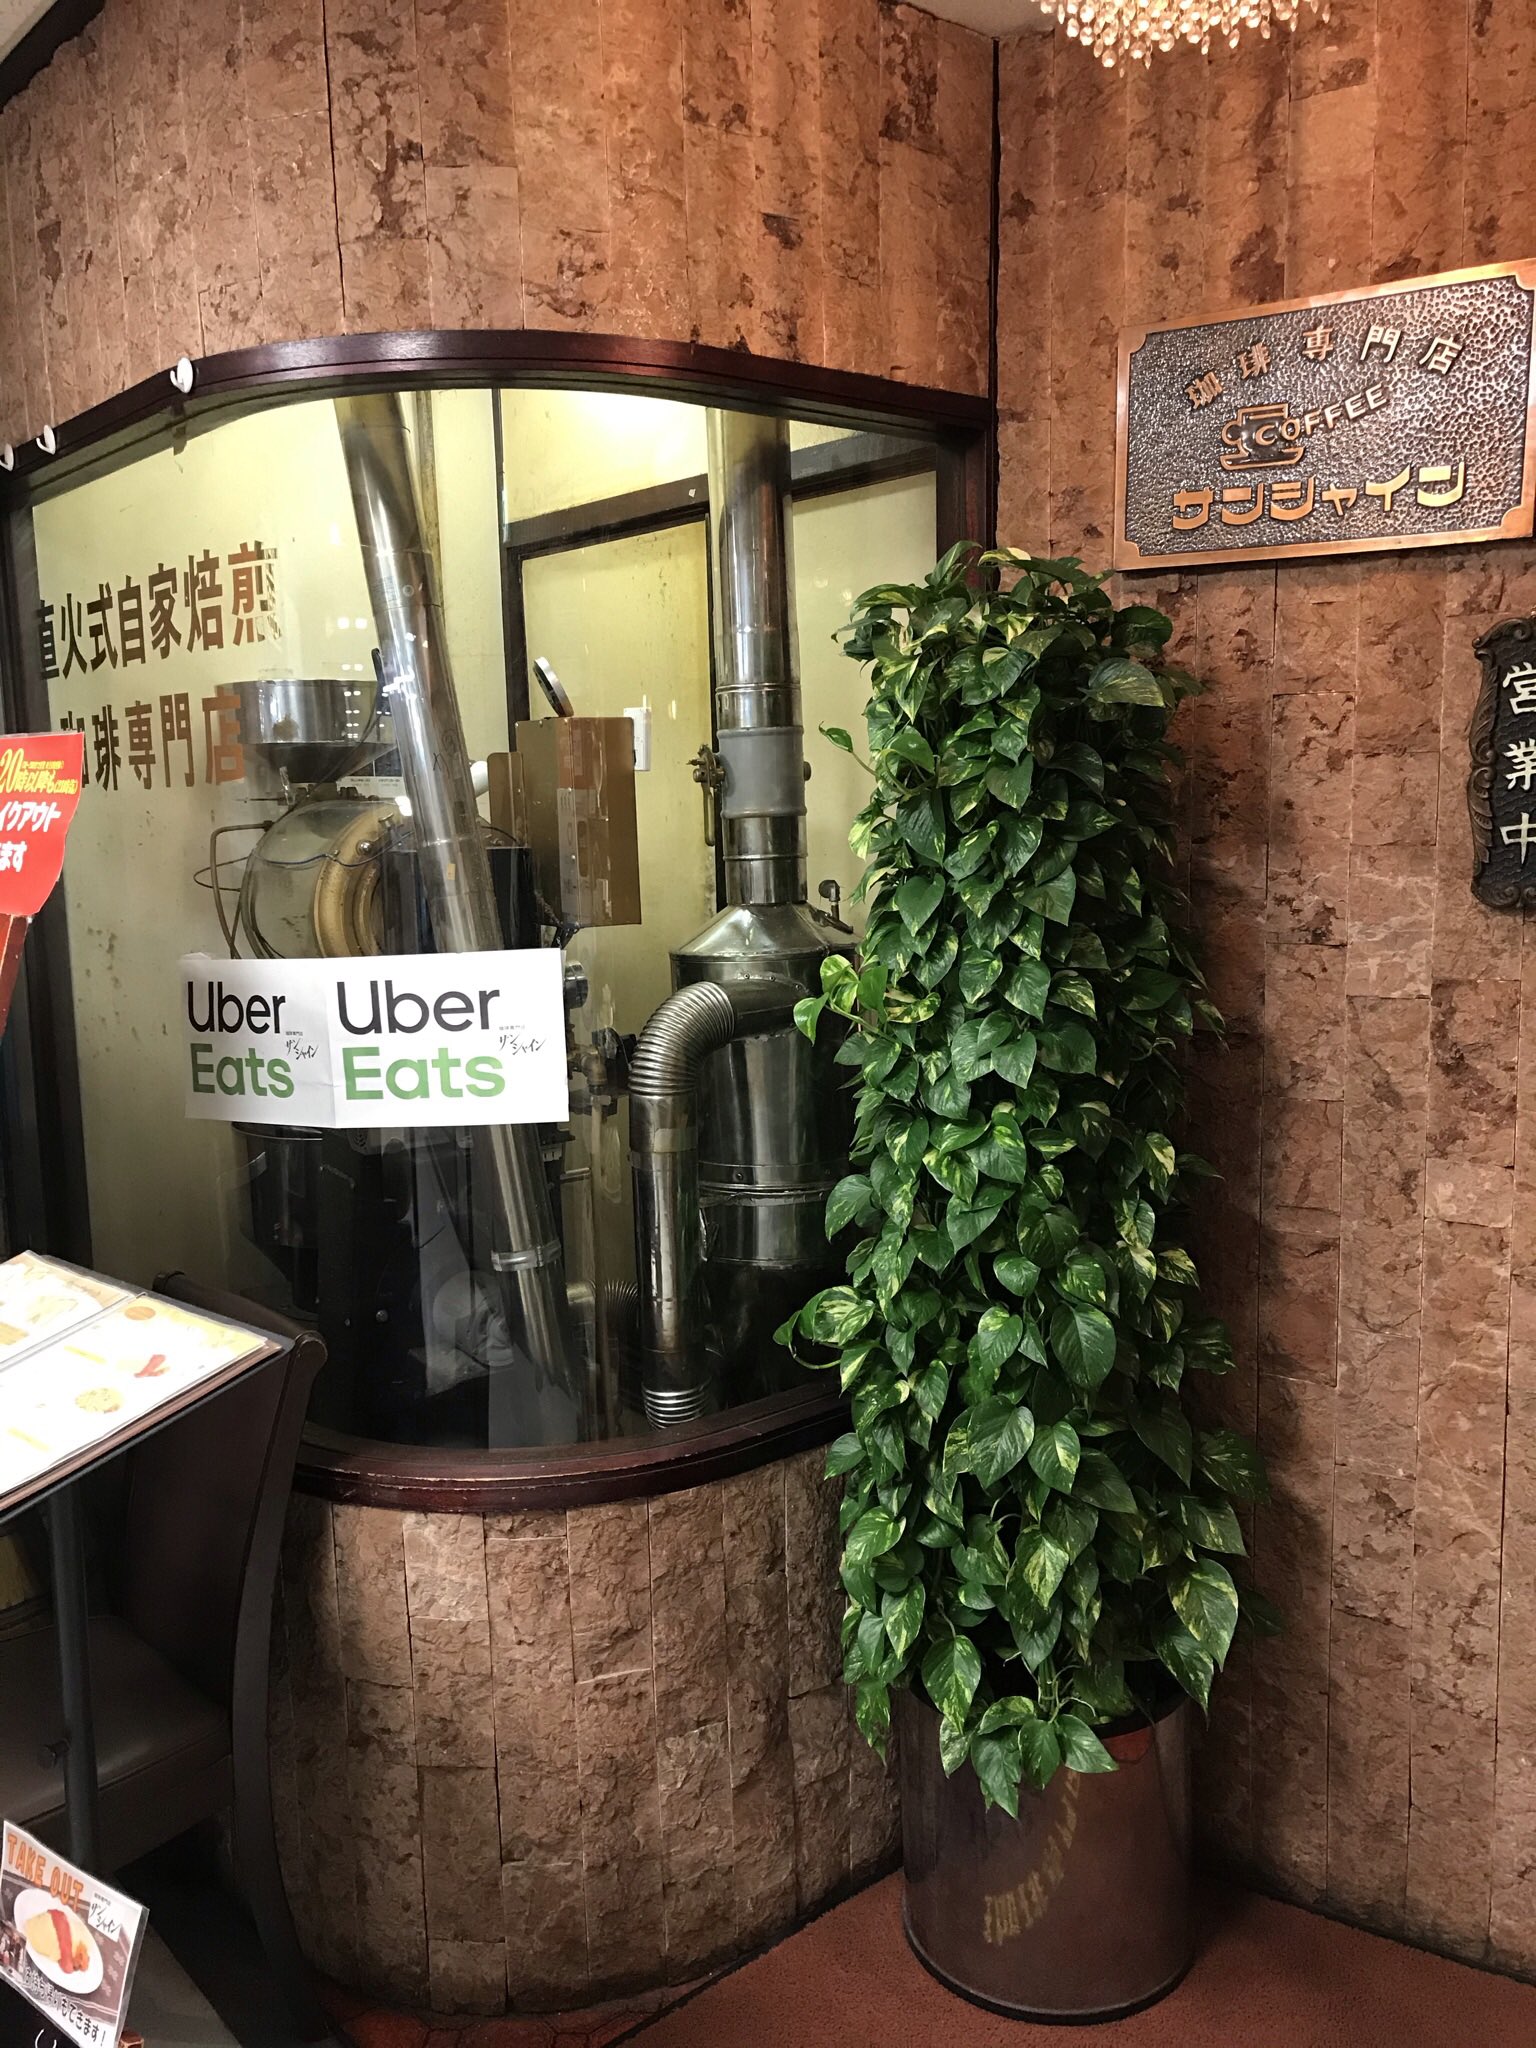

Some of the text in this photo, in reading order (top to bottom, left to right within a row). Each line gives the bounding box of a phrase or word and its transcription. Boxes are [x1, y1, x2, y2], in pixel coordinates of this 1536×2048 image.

[1183, 324, 1464, 409] 珈琲専門店
[1255, 383, 1389, 446] COFFEE
[1172, 462, 1468, 531] サンシャイン
[1498, 661, 1536, 866] 営業中
[187, 981, 286, 1034] Uber
[336, 979, 501, 1035] Uber
[190, 1042, 295, 1099] Eats
[342, 1046, 506, 1101] Eats
[6, 1833, 84, 1913] TAKE OUT
